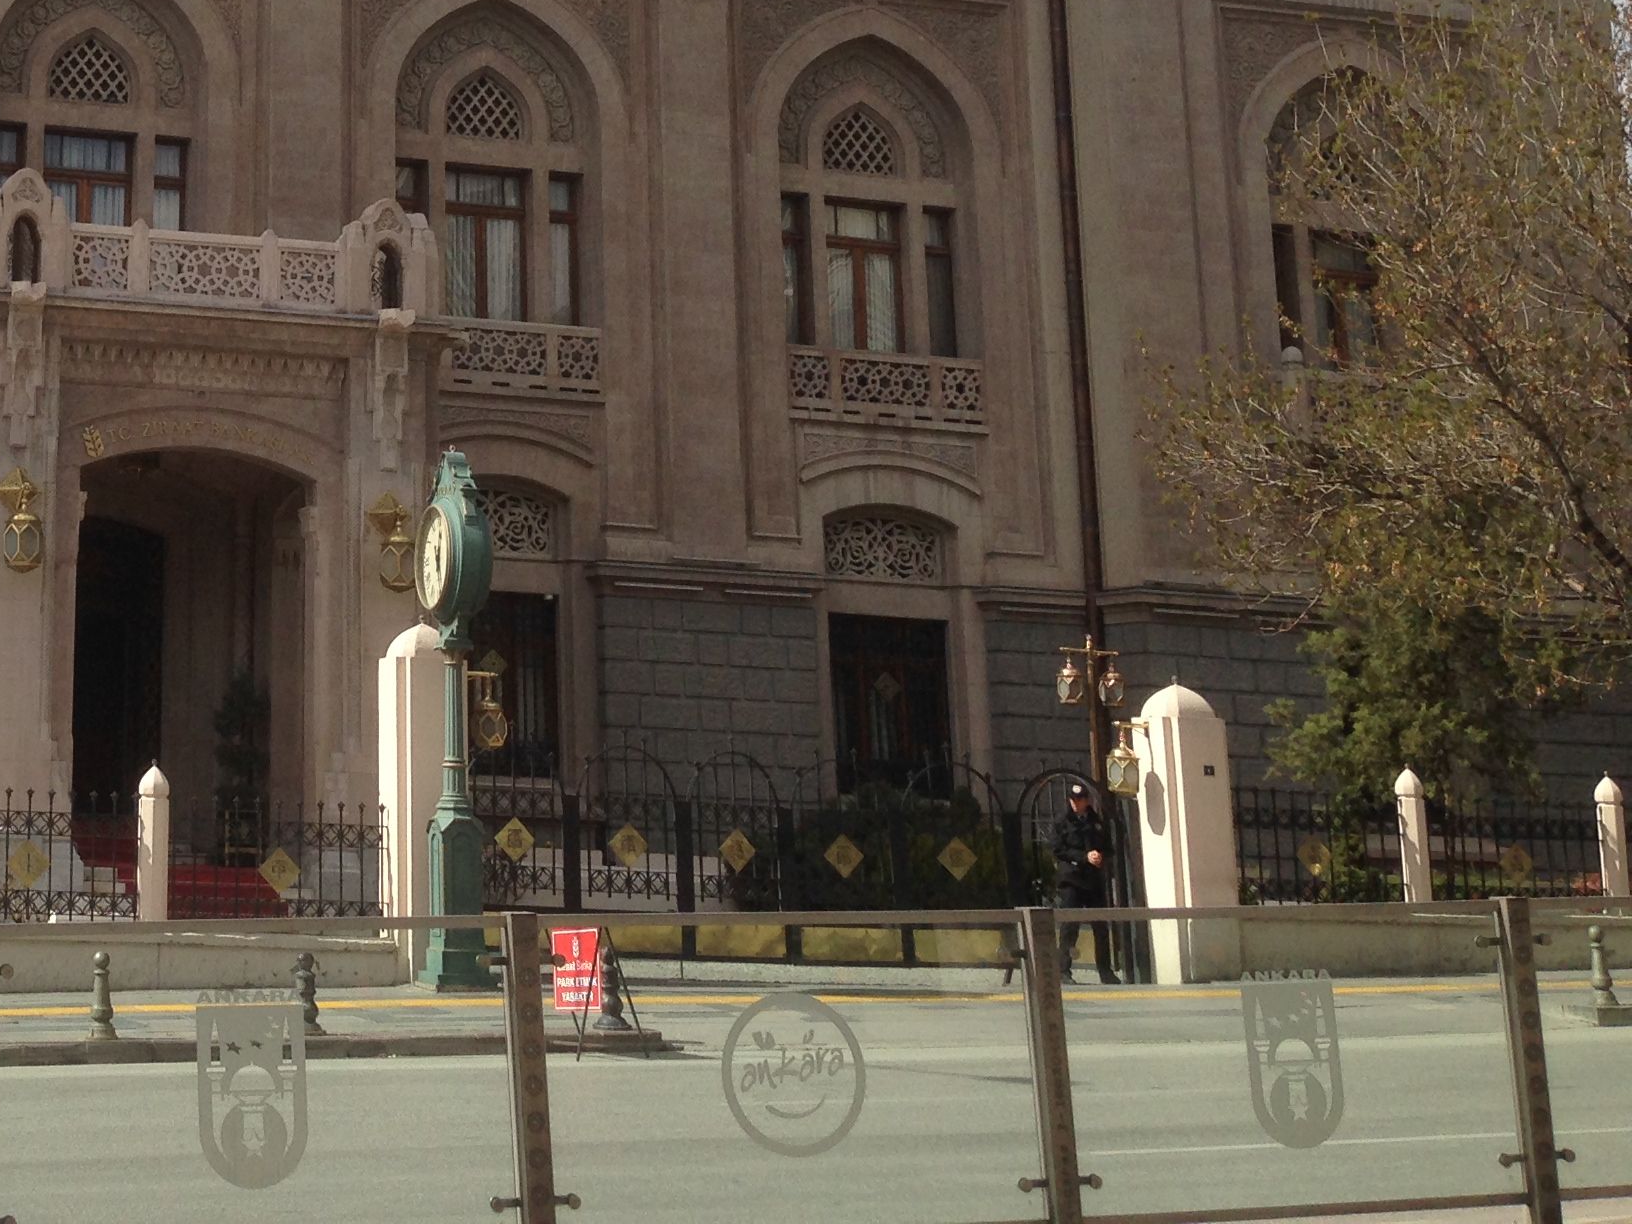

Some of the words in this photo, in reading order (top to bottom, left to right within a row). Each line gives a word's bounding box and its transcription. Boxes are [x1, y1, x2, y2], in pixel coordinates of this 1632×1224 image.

[557, 977, 574, 988] PARK
[575, 976, 598, 987] ETMK
[1240, 968, 1332, 983] ANKARA
[197, 988, 305, 1005] ANKARA
[561, 991, 594, 1003] YASAKTR
[741, 1046, 844, 1093] ankara
